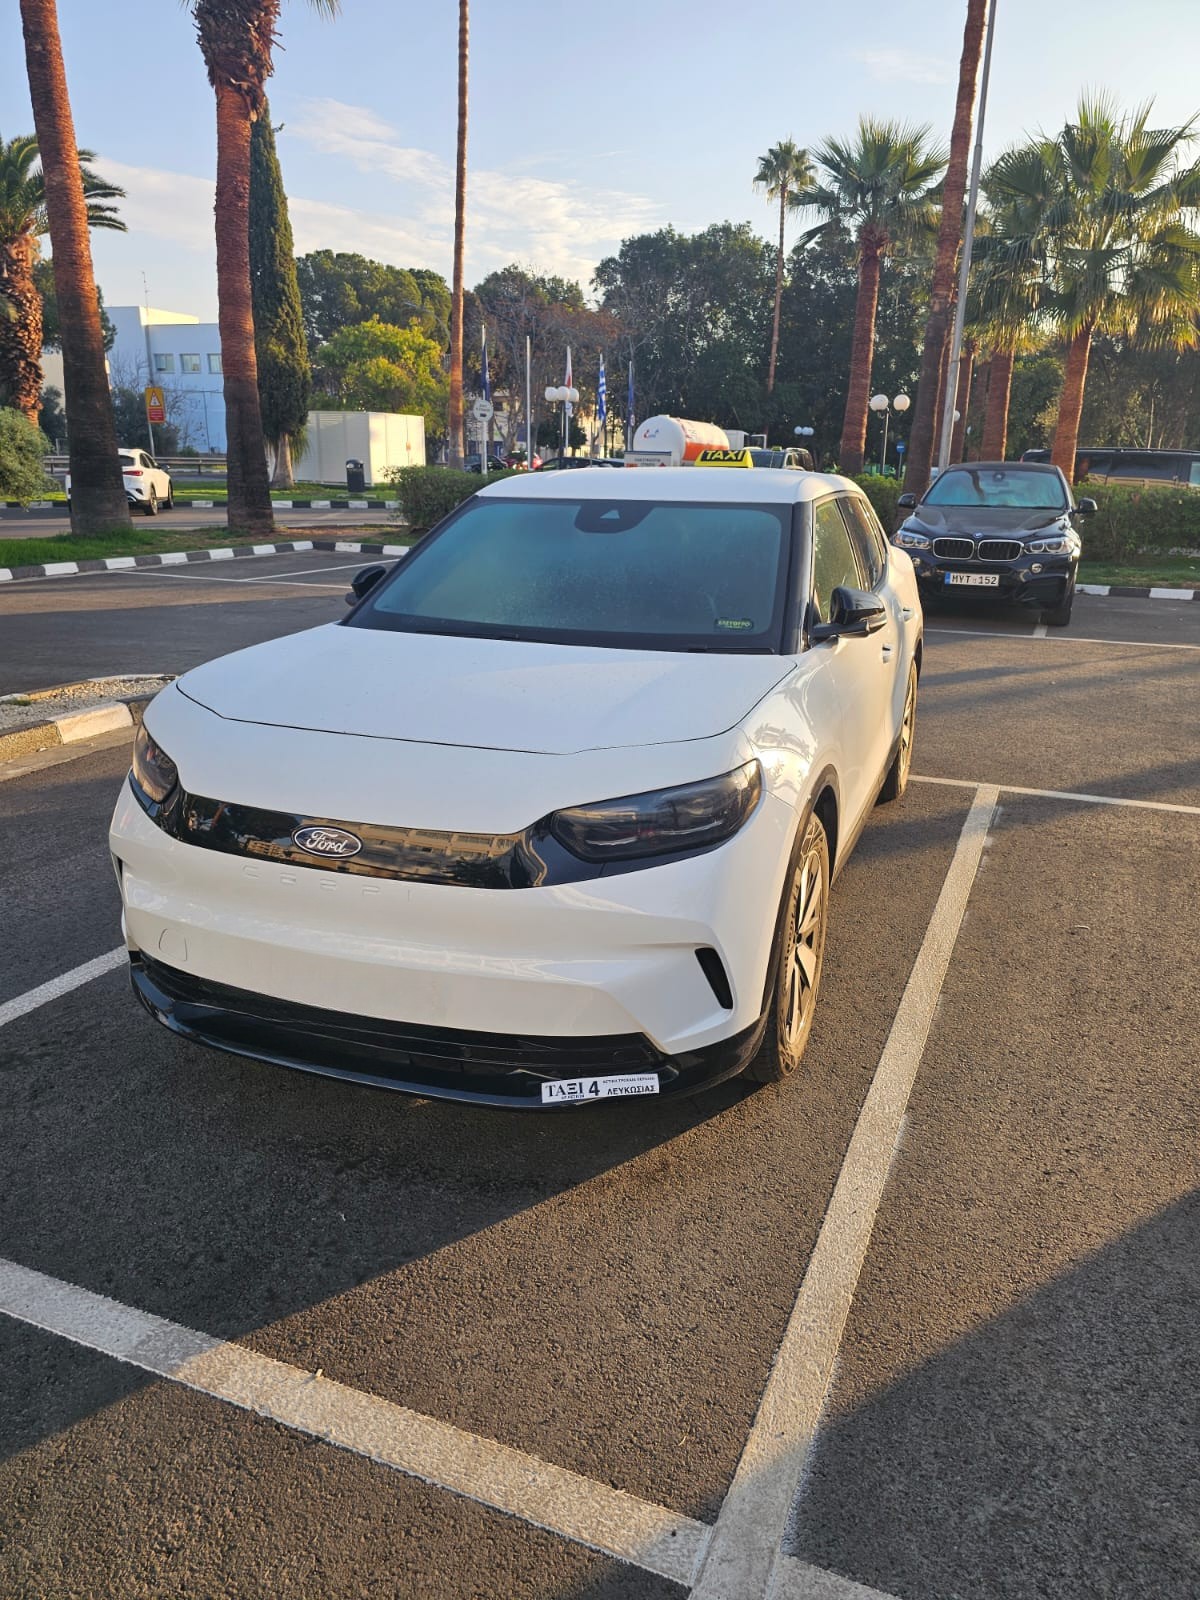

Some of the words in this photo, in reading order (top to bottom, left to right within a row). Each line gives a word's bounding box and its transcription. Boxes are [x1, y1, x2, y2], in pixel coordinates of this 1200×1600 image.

[704, 450, 746, 460] TAXI
[978, 576, 997, 585] 152
[306, 830, 348, 853] Ford
[545, 1082, 583, 1097] ΤΑΞΙ
[588, 1081, 600, 1096] 4
[607, 1085, 656, 1096] ΛΕΥΚΩΣΙΑΣ
